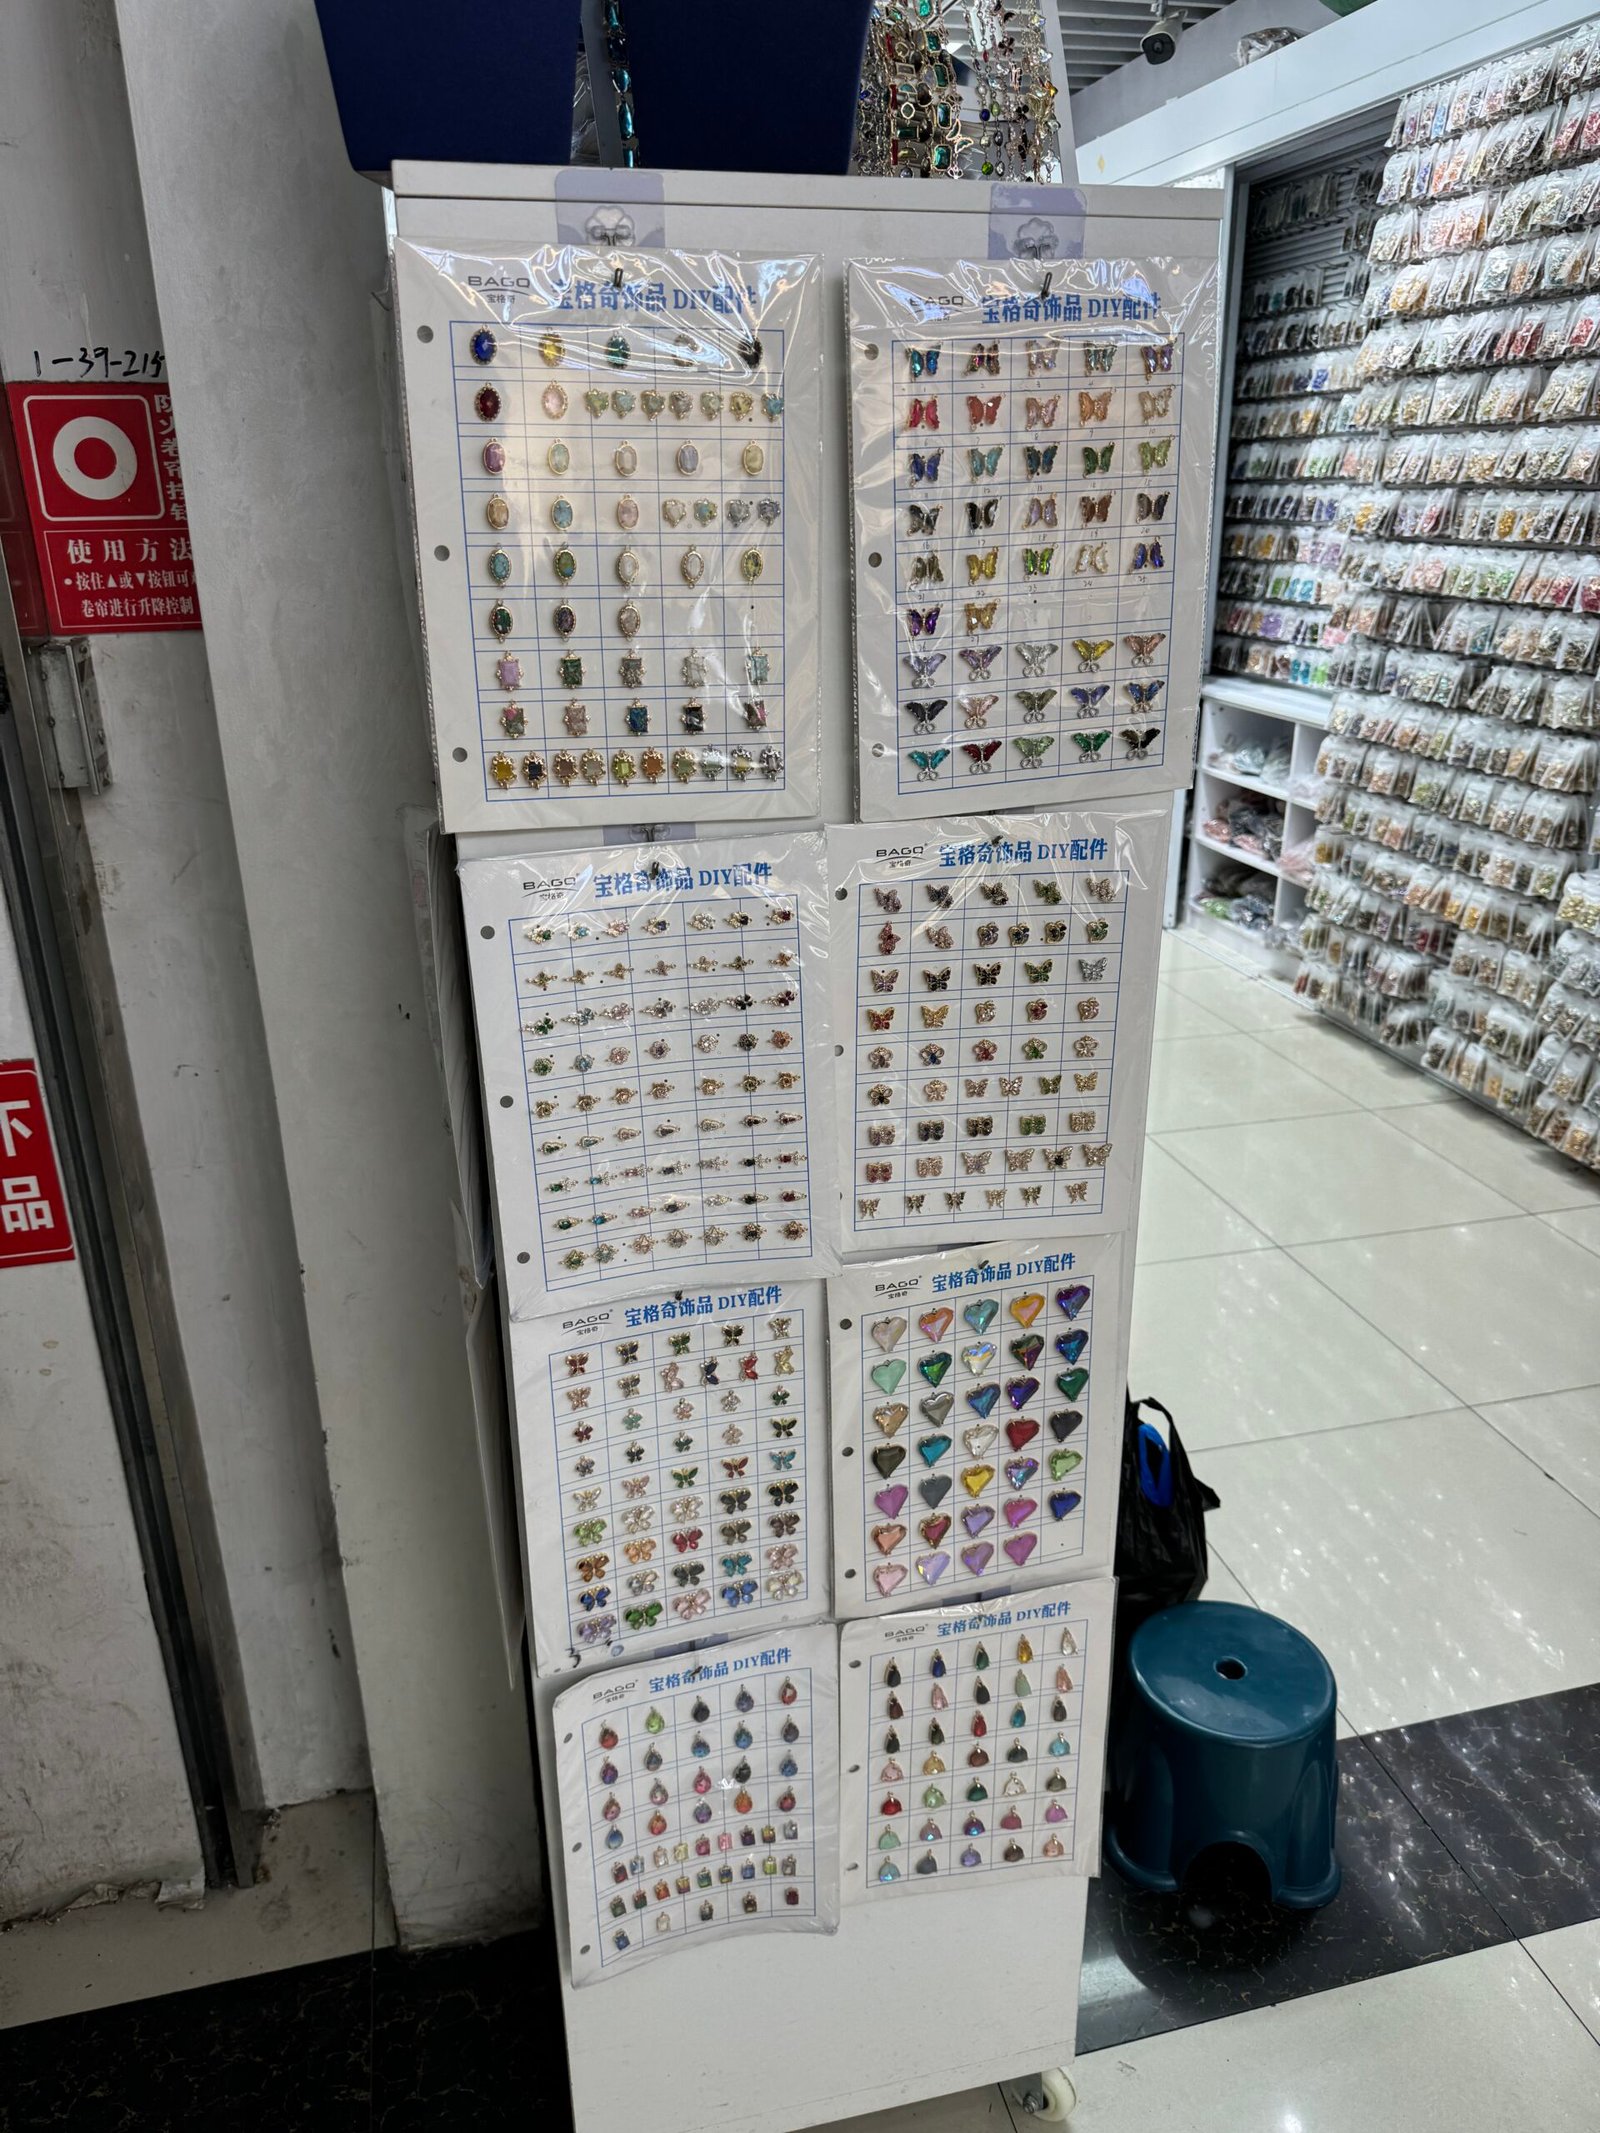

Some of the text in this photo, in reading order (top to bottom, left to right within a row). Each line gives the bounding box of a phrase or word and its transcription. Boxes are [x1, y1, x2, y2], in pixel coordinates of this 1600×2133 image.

[981, 292, 1161, 324] 宝格奇饰品 DIY配件
[67, 537, 193, 564] 使用方法
[81, 596, 194, 618] 卷帘进行升降控制
[939, 838, 1109, 868] 宝格奇饰品 DIY配件
[593, 862, 773, 898] 宝格奇饰品 DIY配件
[0, 1175, 55, 1233] 品
[932, 1252, 1077, 1293] 宝格奇饰品 DIY配件
[624, 1285, 783, 1328] 宝格奇饰品 DIY配件
[937, 1600, 1072, 1638] 宝格奇饰品 DIY配件
[648, 1646, 793, 1694] 宝格奇饰品 DIY配件
